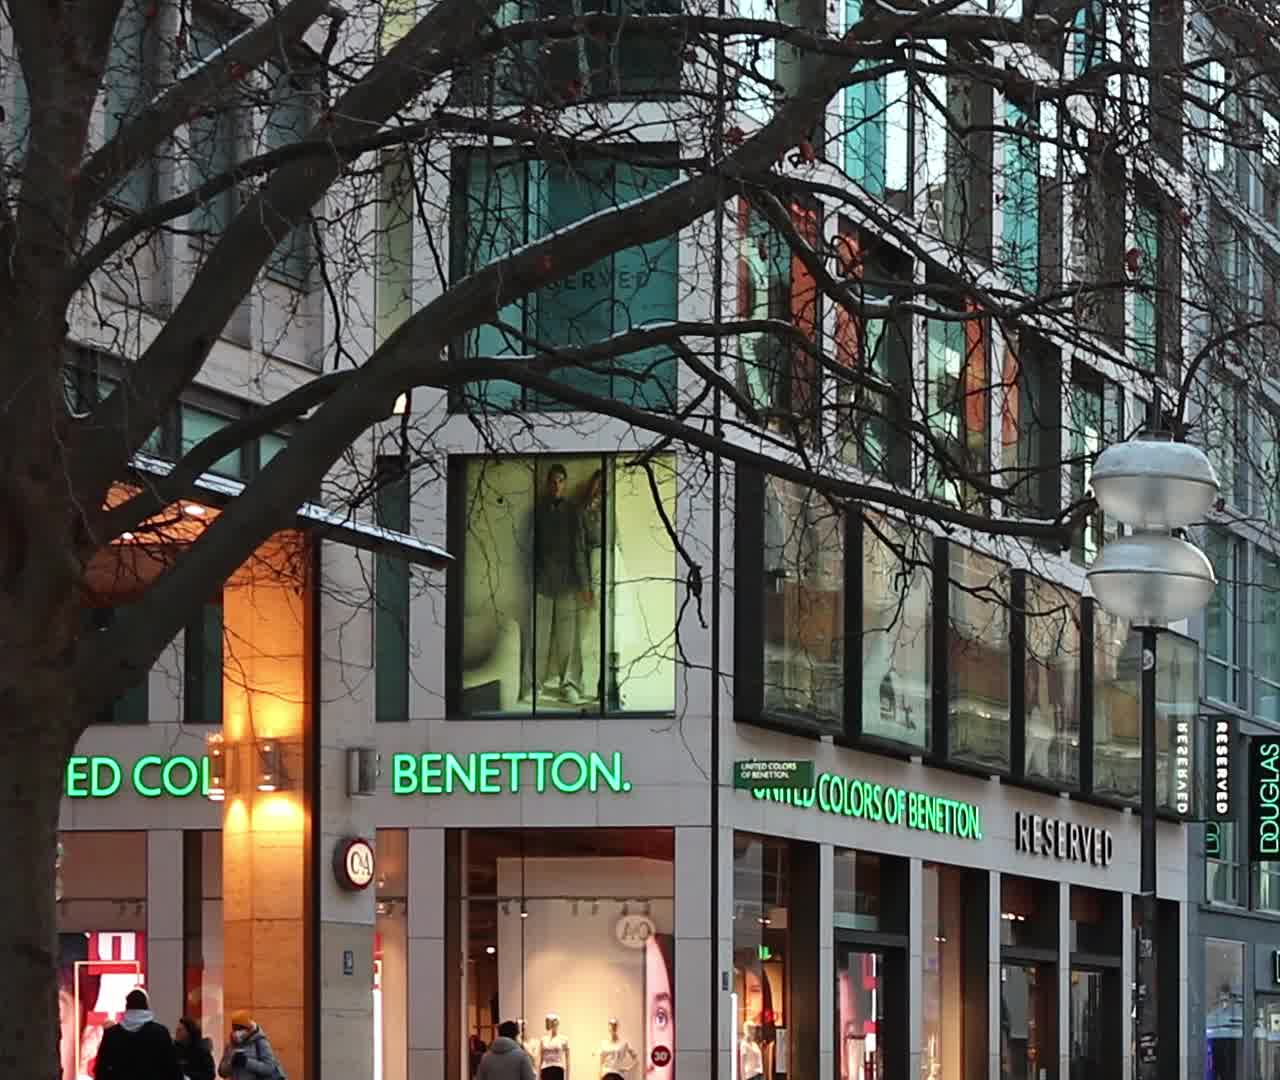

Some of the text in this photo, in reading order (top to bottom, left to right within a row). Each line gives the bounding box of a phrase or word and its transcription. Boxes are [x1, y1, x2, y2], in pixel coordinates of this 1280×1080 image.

[66, 754, 210, 797] ED COL
[393, 751, 632, 794] BENETTON.
[1216, 721, 1228, 814] RESERVED
[1260, 743, 1280, 853] DOUGLAS
[818, 773, 883, 821] COLORS
[884, 787, 905, 825] OF
[907, 791, 982, 840] BENETTON.
[1015, 810, 1113, 867] RESERVED
